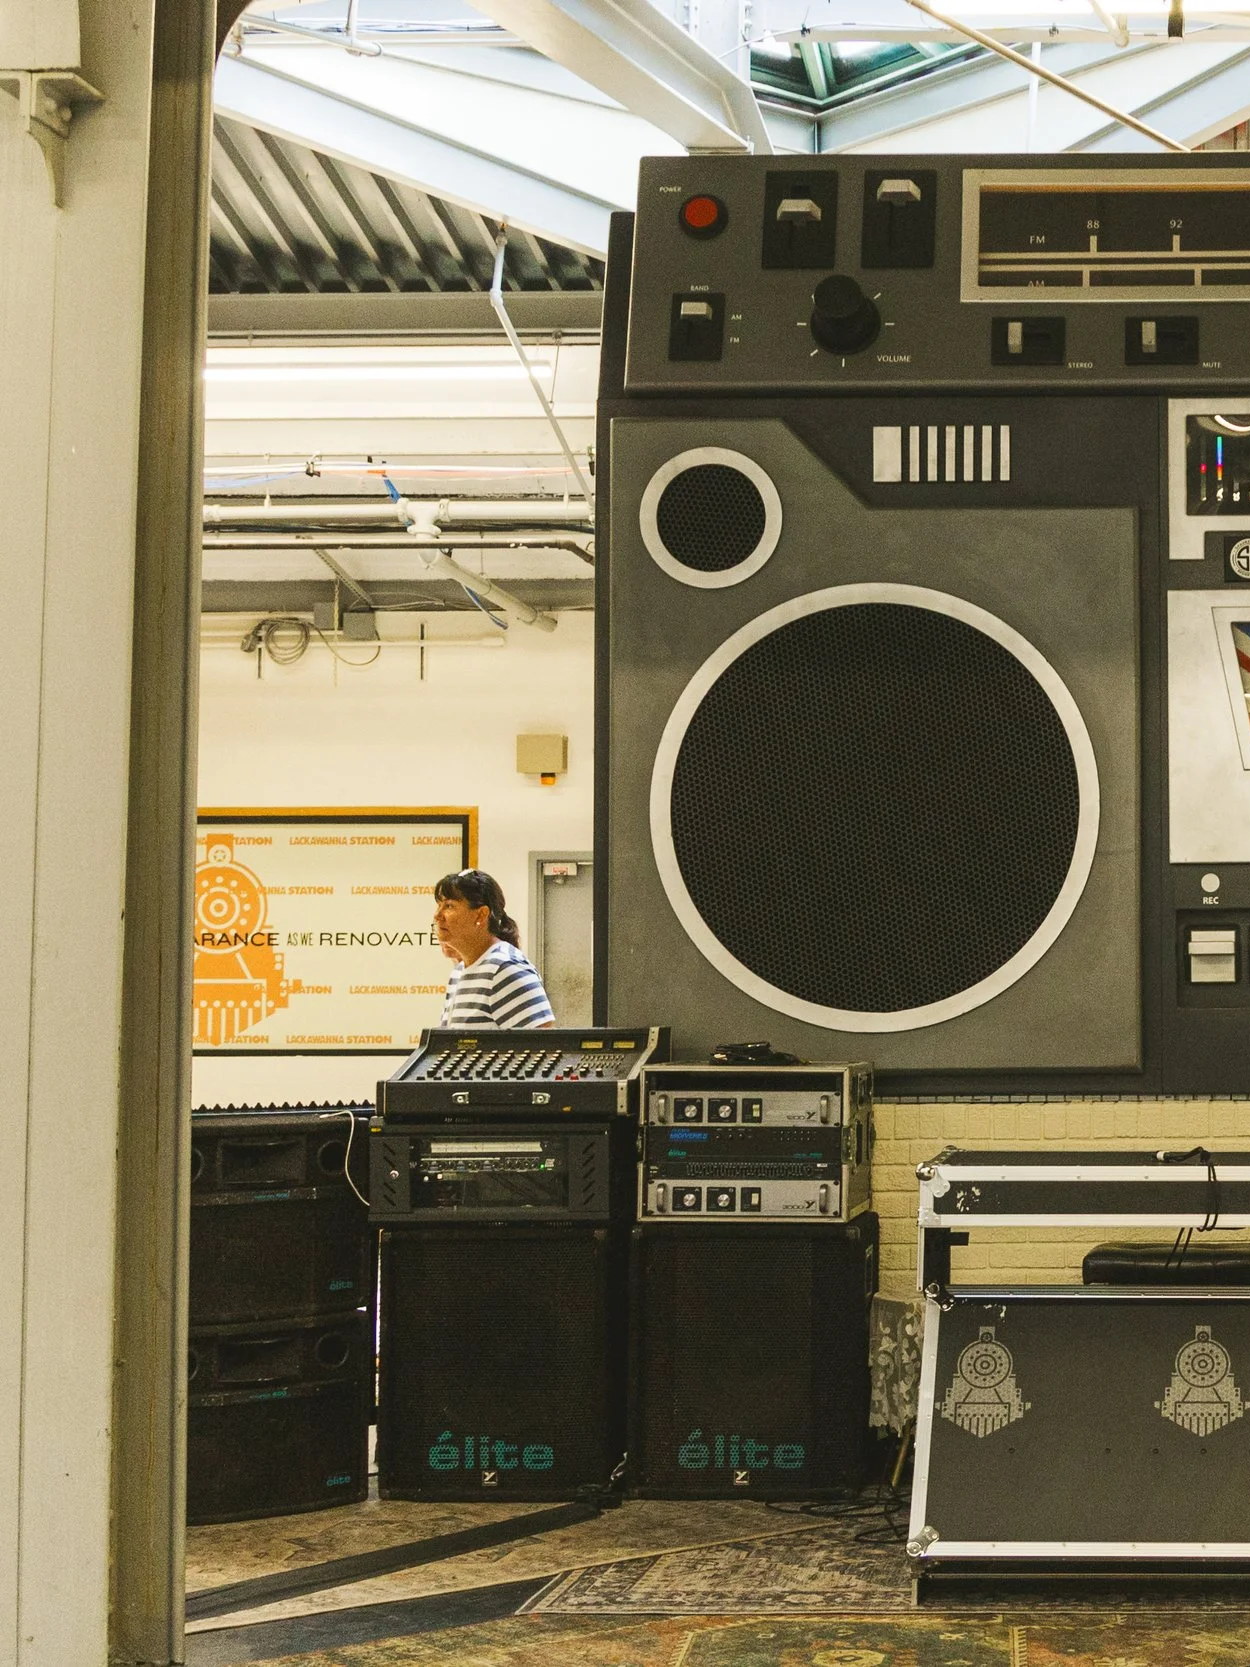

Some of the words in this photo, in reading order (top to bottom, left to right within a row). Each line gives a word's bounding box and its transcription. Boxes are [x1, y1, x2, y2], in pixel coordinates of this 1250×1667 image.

[659, 186, 682, 194] POWER
[1086, 220, 1100, 229] 88
[1169, 220, 1183, 229] 92
[1030, 235, 1045, 245] FM
[877, 355, 912, 363] VOLUME
[235, 837, 272, 845] TATION
[289, 836, 347, 845] LACKAWANNA
[350, 836, 395, 845] STATION
[288, 886, 334, 895] STATION
[351, 886, 409, 895] LACKAWANNA
[1202, 896, 1219, 905] REC
[287, 932, 299, 946] AS
[301, 932, 314, 946] WE
[319, 931, 440, 946] RENOVATE
[349, 985, 407, 994] LACKAWANNA
[286, 1035, 344, 1044] LACKAWANNA
[347, 1035, 392, 1044] STATION
[428, 1430, 554, 1470] élite
[678, 1428, 806, 1469] élite
